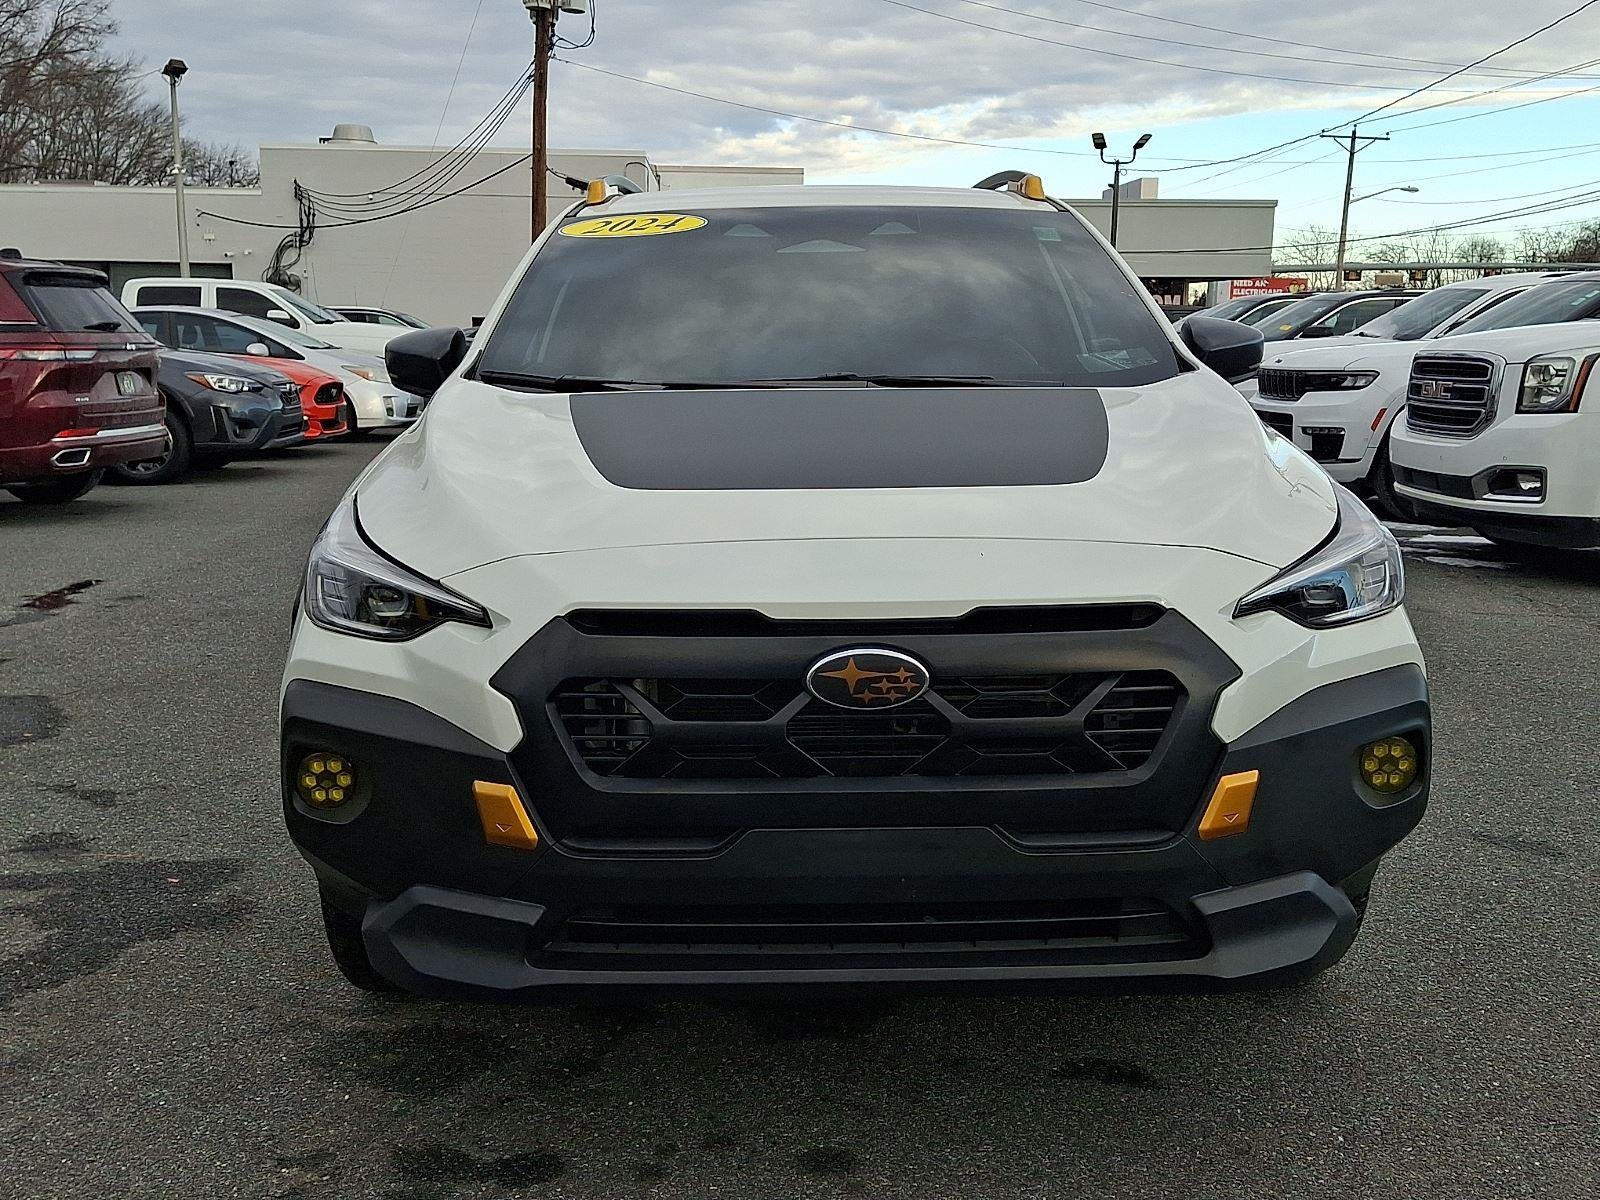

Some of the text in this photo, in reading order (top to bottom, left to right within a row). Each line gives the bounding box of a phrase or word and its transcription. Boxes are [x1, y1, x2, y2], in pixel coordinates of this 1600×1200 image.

[580, 216, 688, 235] 2024
[1233, 279, 1254, 287] NEED
[1421, 380, 1453, 399] GMC
